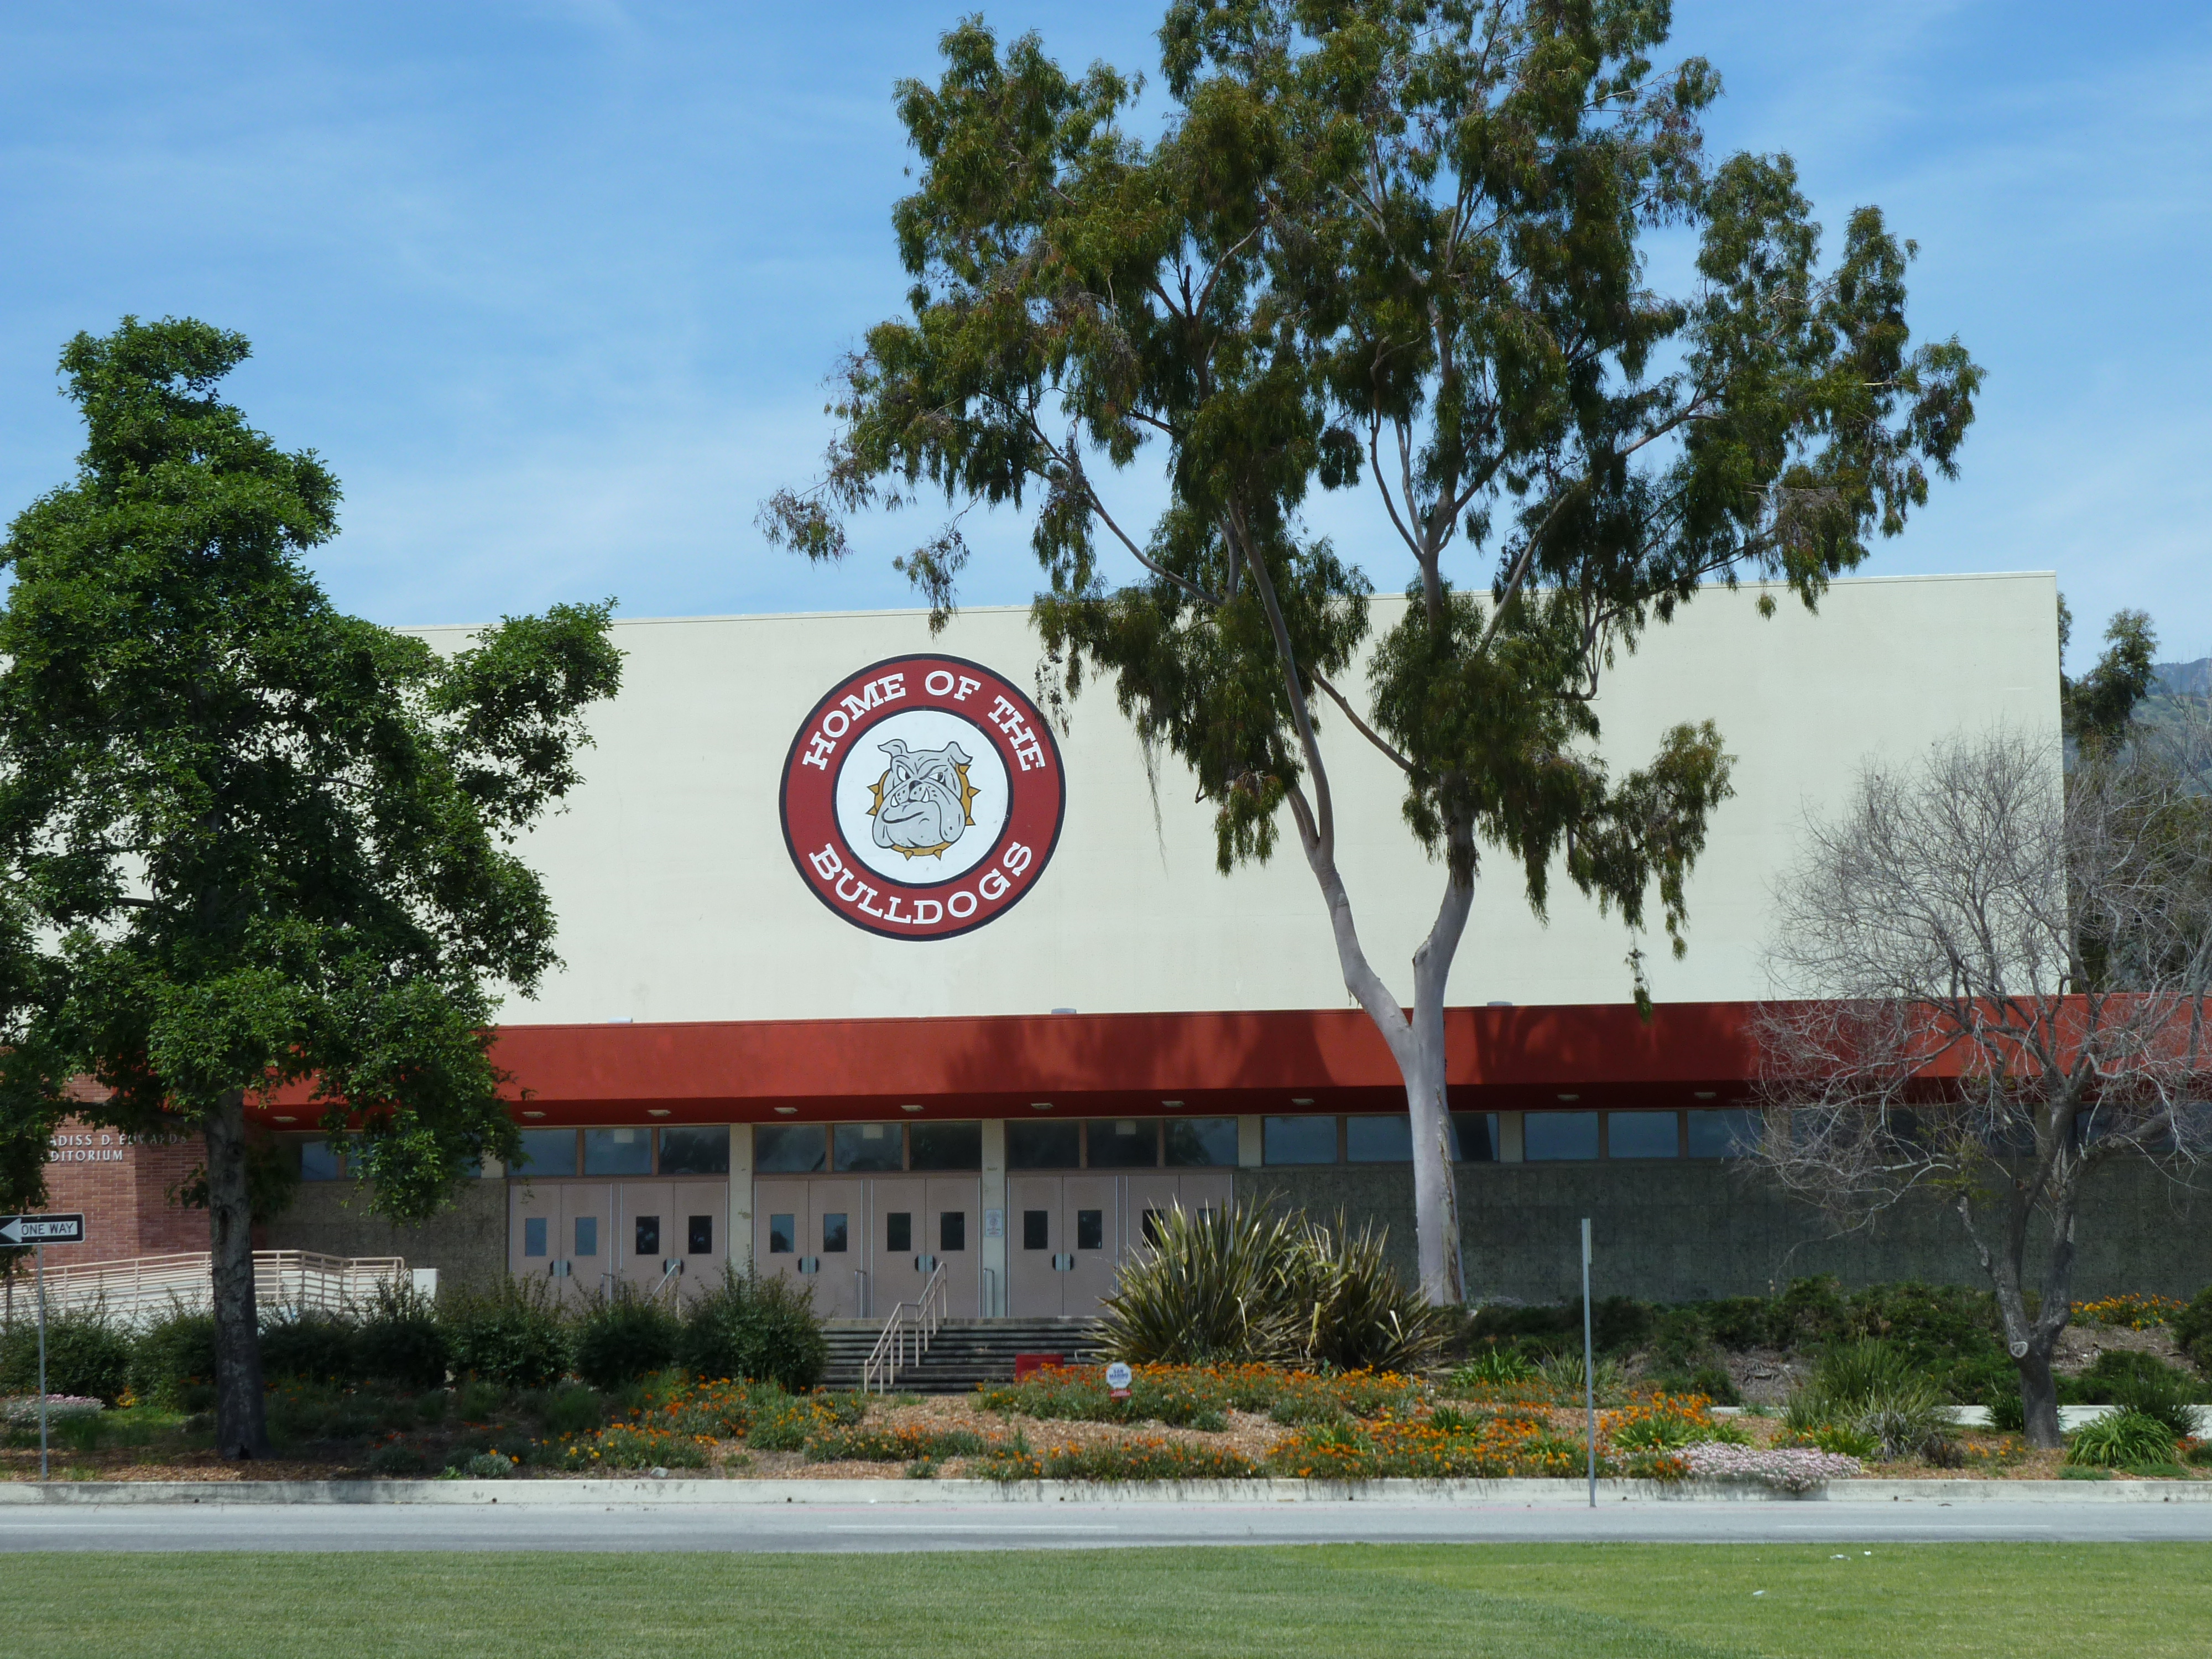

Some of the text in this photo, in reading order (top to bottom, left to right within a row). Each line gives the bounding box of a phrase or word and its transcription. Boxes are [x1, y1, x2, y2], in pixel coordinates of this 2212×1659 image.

[802, 670, 1046, 772] HOME OF THE
[808, 842, 1032, 924] BULLDOGS
[49, 1134, 92, 1146] ADISS
[101, 1134, 113, 1146] D.
[50, 1149, 123, 1161] DITORIUM
[22, 1223, 74, 1235] ONE WAY
